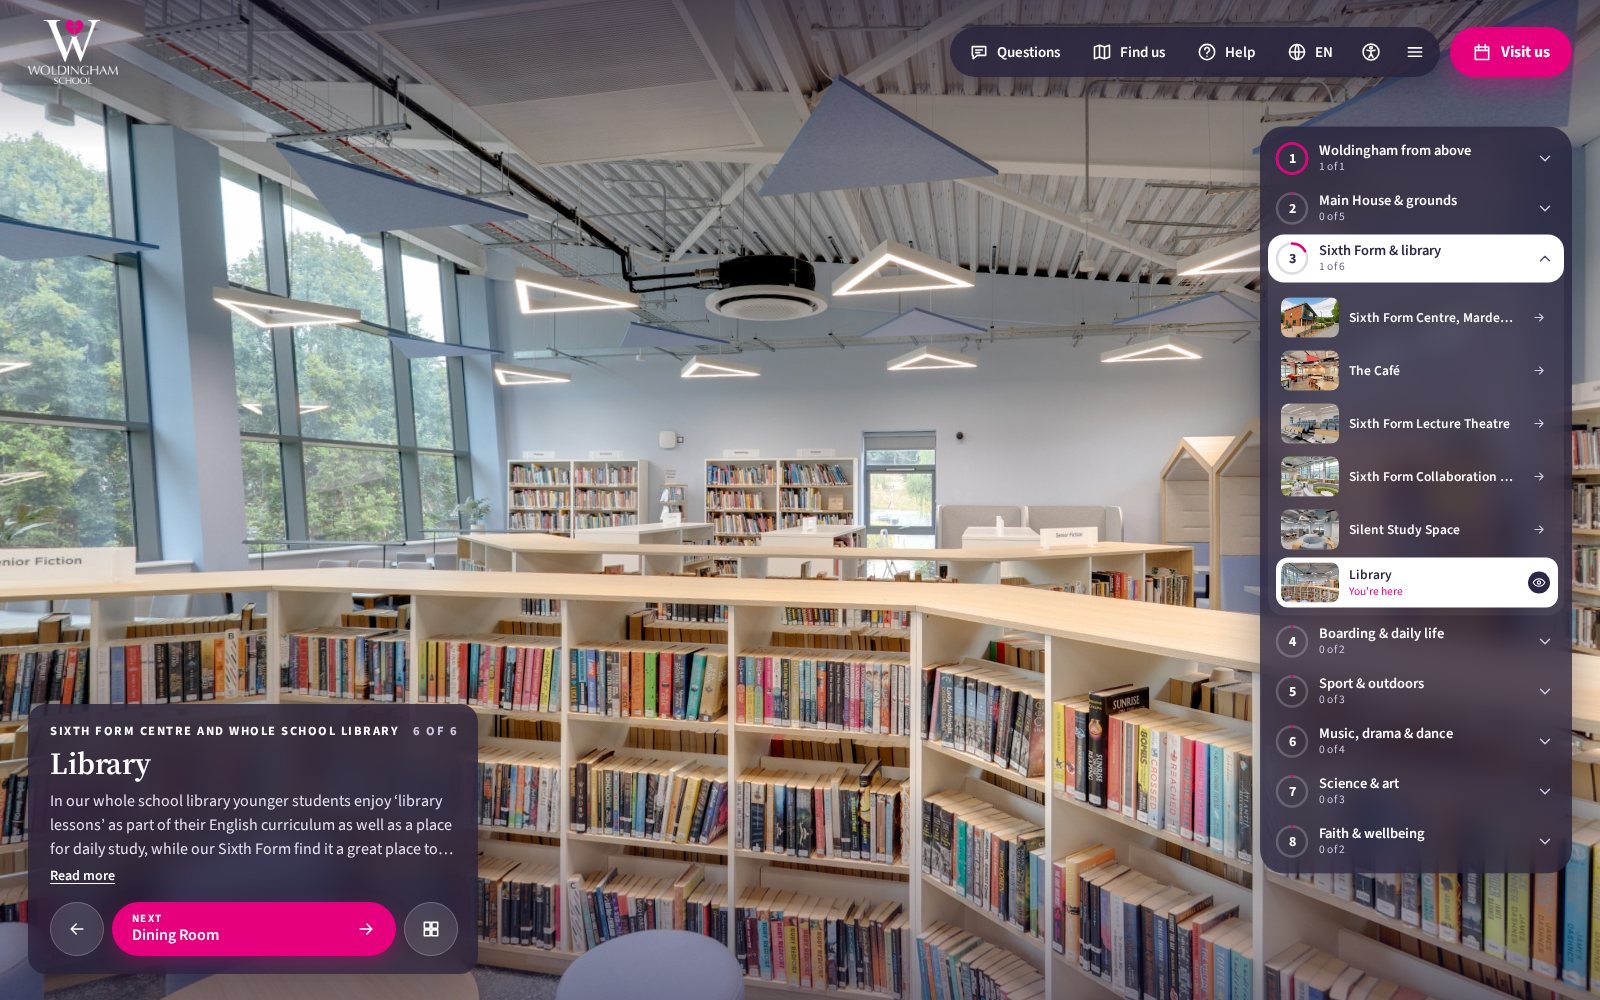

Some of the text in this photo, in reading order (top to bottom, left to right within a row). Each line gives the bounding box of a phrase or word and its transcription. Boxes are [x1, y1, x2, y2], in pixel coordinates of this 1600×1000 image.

[0, 556, 82, 567] nior Fiction
[1112, 694, 1140, 711] SUNRISE
[1139, 729, 1148, 765] BOMBS
[1096, 753, 1104, 783] SUNRISE
[1149, 759, 1158, 810] CROSSED
[1169, 764, 1178, 817] REACHED
[1216, 950, 1226, 988] TOFFEE
